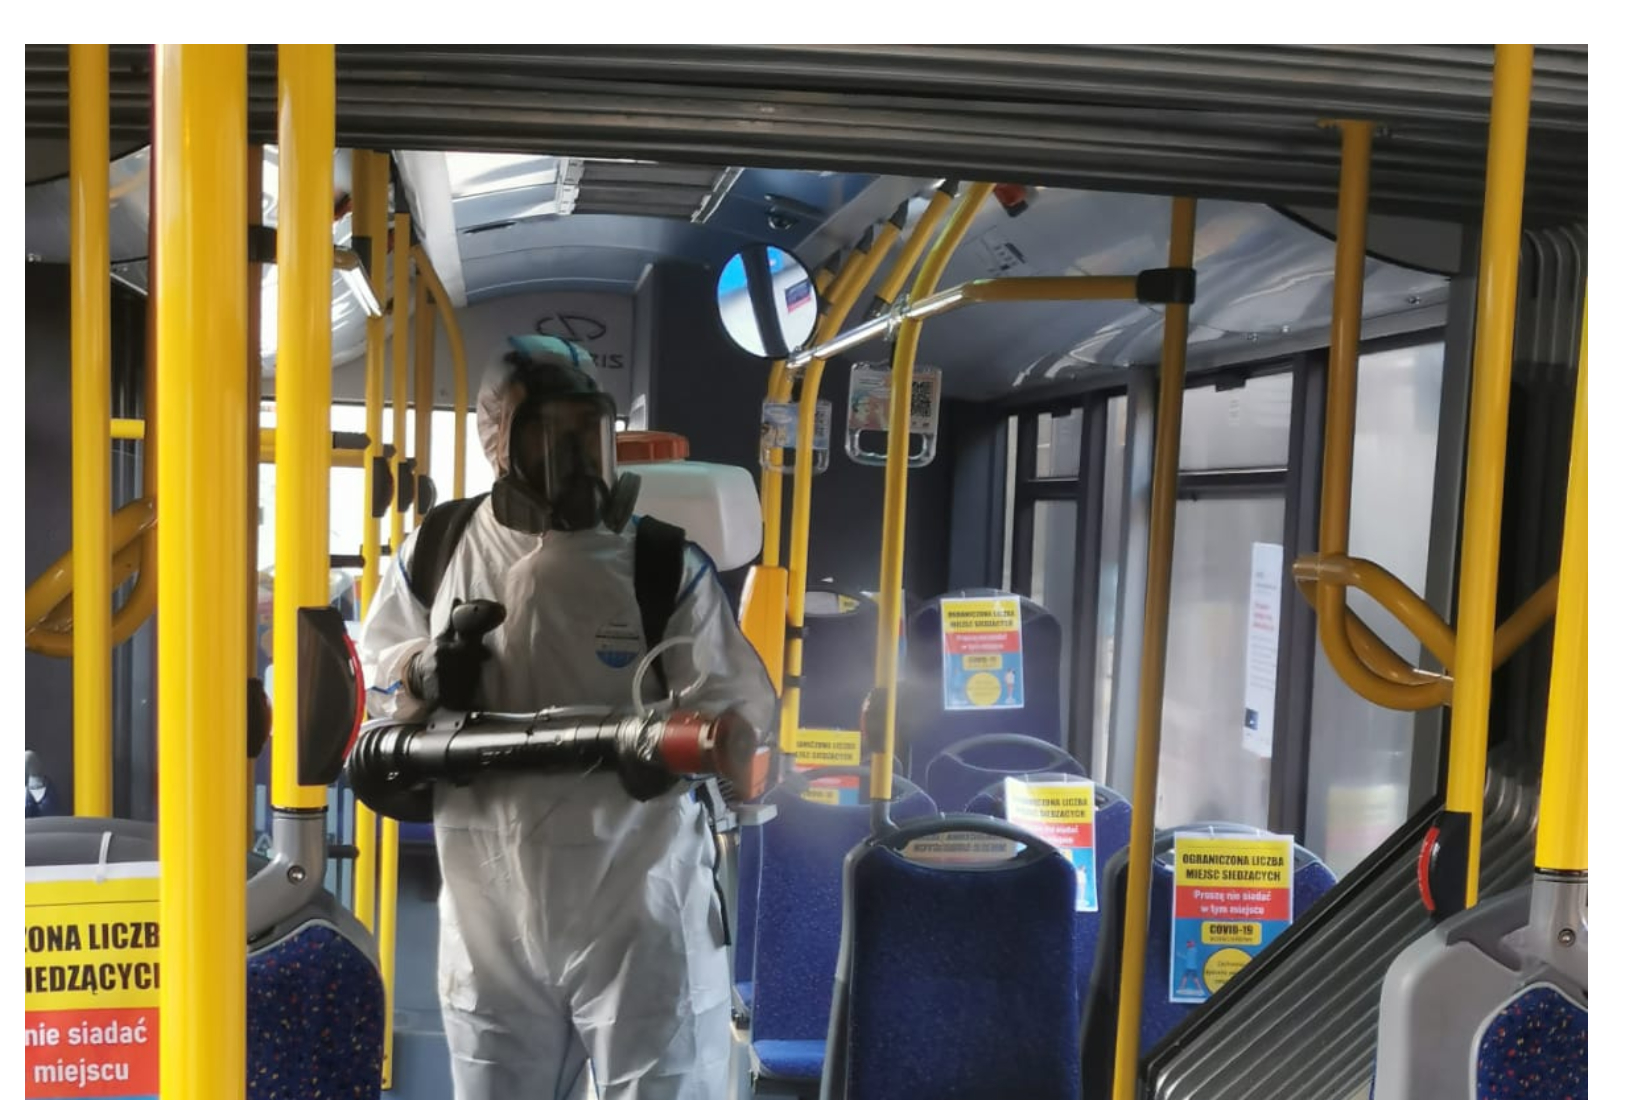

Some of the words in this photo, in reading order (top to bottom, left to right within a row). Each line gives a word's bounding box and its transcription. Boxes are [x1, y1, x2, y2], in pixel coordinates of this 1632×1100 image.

[1182, 854, 1249, 866] OGRANICZONA
[1252, 857, 1284, 867] LICZBA
[1209, 924, 1254, 935] COVID-19
[68, 1016, 148, 1045] siadać
[34, 1058, 129, 1088] miejscu
